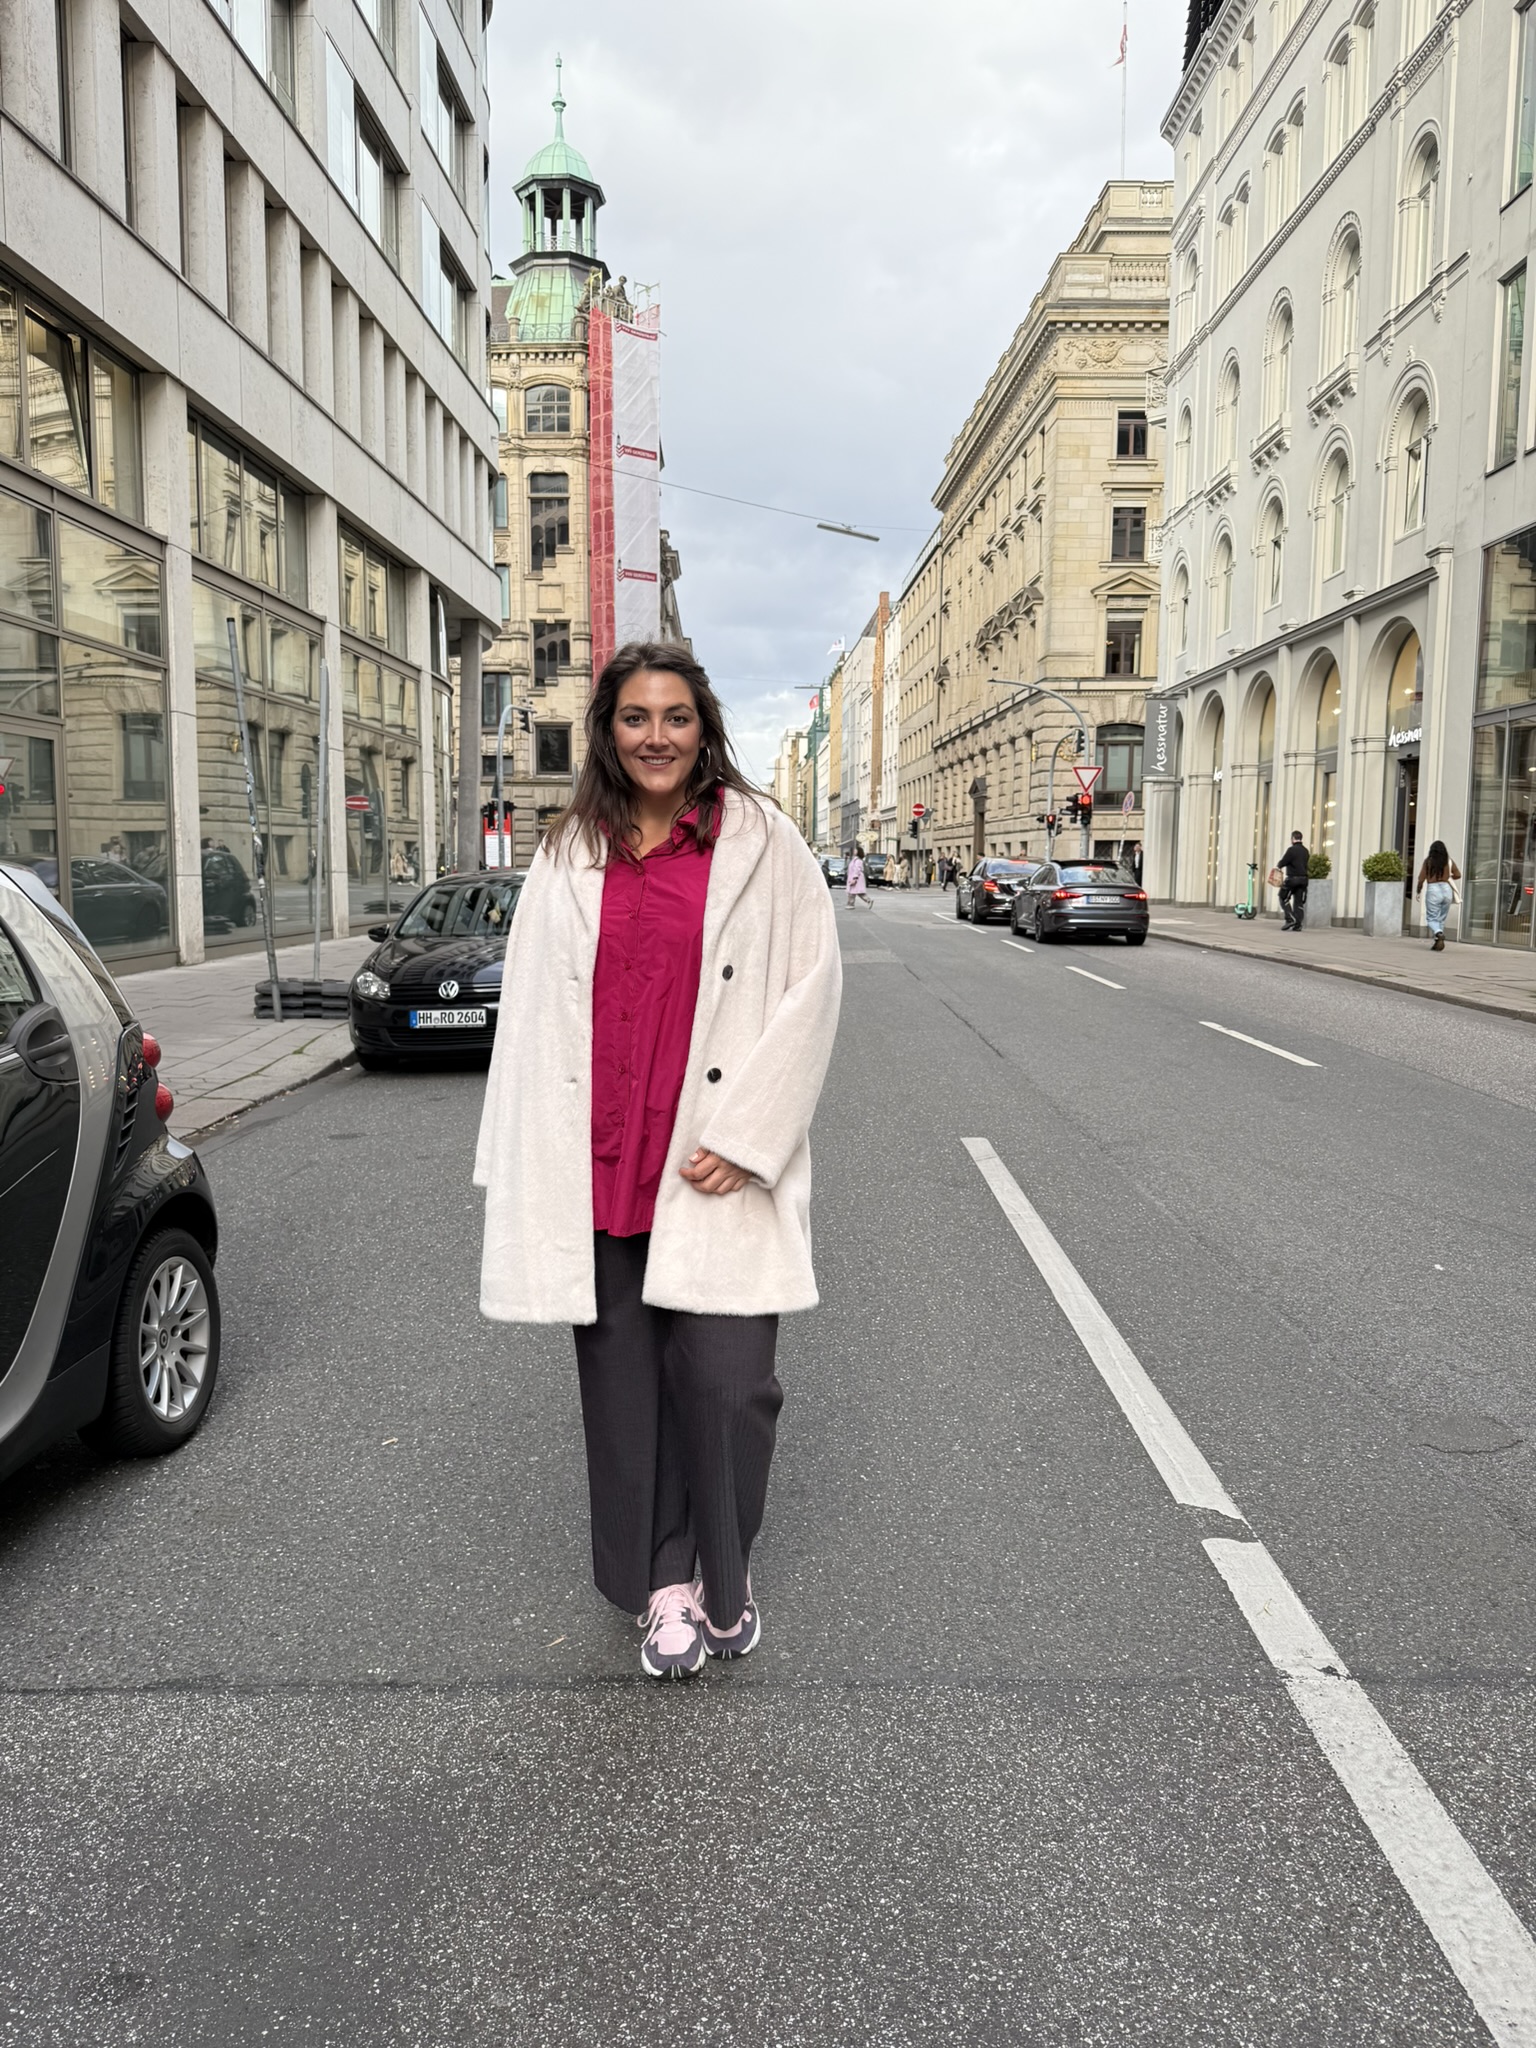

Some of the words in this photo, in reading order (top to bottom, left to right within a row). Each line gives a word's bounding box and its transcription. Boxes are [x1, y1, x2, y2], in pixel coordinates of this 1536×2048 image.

[1151, 703, 1168, 772] hessnatur
[1388, 725, 1422, 747] hessna
[418, 1012, 432, 1024] HH
[440, 1012, 454, 1024] RO
[457, 1011, 484, 1024] 2604
